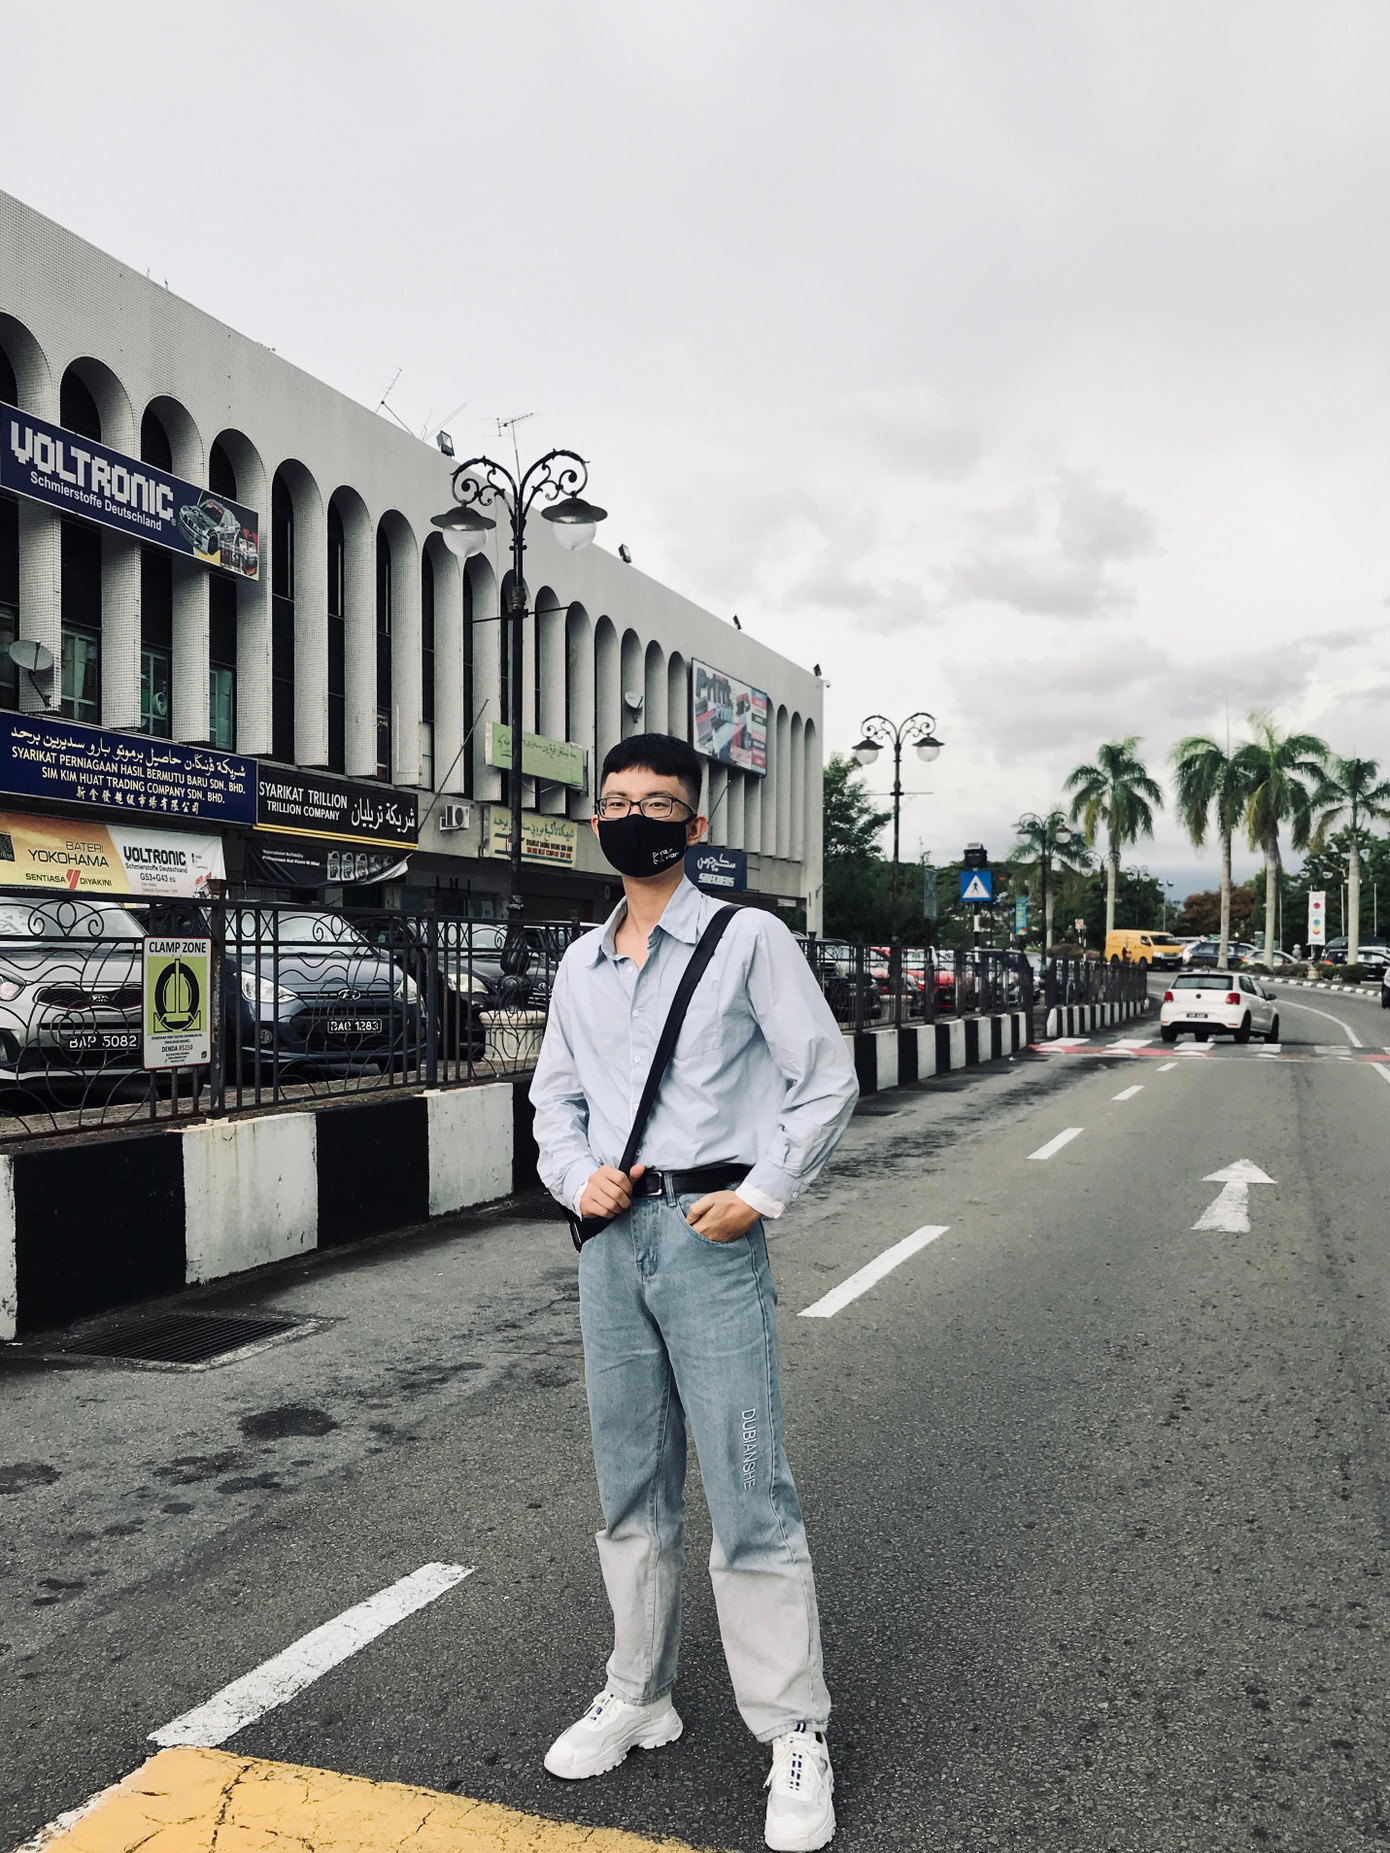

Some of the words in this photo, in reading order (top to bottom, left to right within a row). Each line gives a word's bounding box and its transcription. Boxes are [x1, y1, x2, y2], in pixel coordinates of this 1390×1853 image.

[11, 420, 174, 521] VOLTRONIC
[30, 472, 102, 508] Schmierstoffe
[104, 499, 162, 531] Deutschland
[12, 746, 57, 764] SYARIKAT
[59, 754, 118, 773] PERNIAGAAN
[120, 764, 145, 778] HASIL
[146, 768, 184, 784] BERMUTU
[187, 775, 208, 788] BARU
[210, 779, 227, 791] SDN.
[228, 782, 246, 794] BHD.
[42, 767, 58, 780] SIM
[60, 769, 77, 782] KIM
[80, 773, 104, 786] HUAT
[106, 776, 145, 792] TRADING
[147, 782, 186, 798] COMPANY
[187, 788, 205, 801] SDN.
[208, 792, 225, 804] BHD.
[259, 781, 304, 802] SYARIKAT
[308, 790, 348, 809] TRILLION
[267, 800, 301, 815] TRILLION
[303, 806, 340, 821] COMPANY
[385, 802, 415, 833] شريكة
[28, 849, 109, 868] YOKOHAMA
[66, 841, 104, 853] BATERI
[123, 846, 186, 866] VOLTRONIC
[26, 873, 66, 883] SENTIASA
[80, 878, 112, 886] DIYAKINI
[148, 942, 180, 953] CLAMP
[182, 942, 206, 953] ZONE
[69, 1035, 96, 1048] BAP
[102, 1035, 137, 1048] 5082
[742, 1408, 757, 1490] DUBIANSHE
